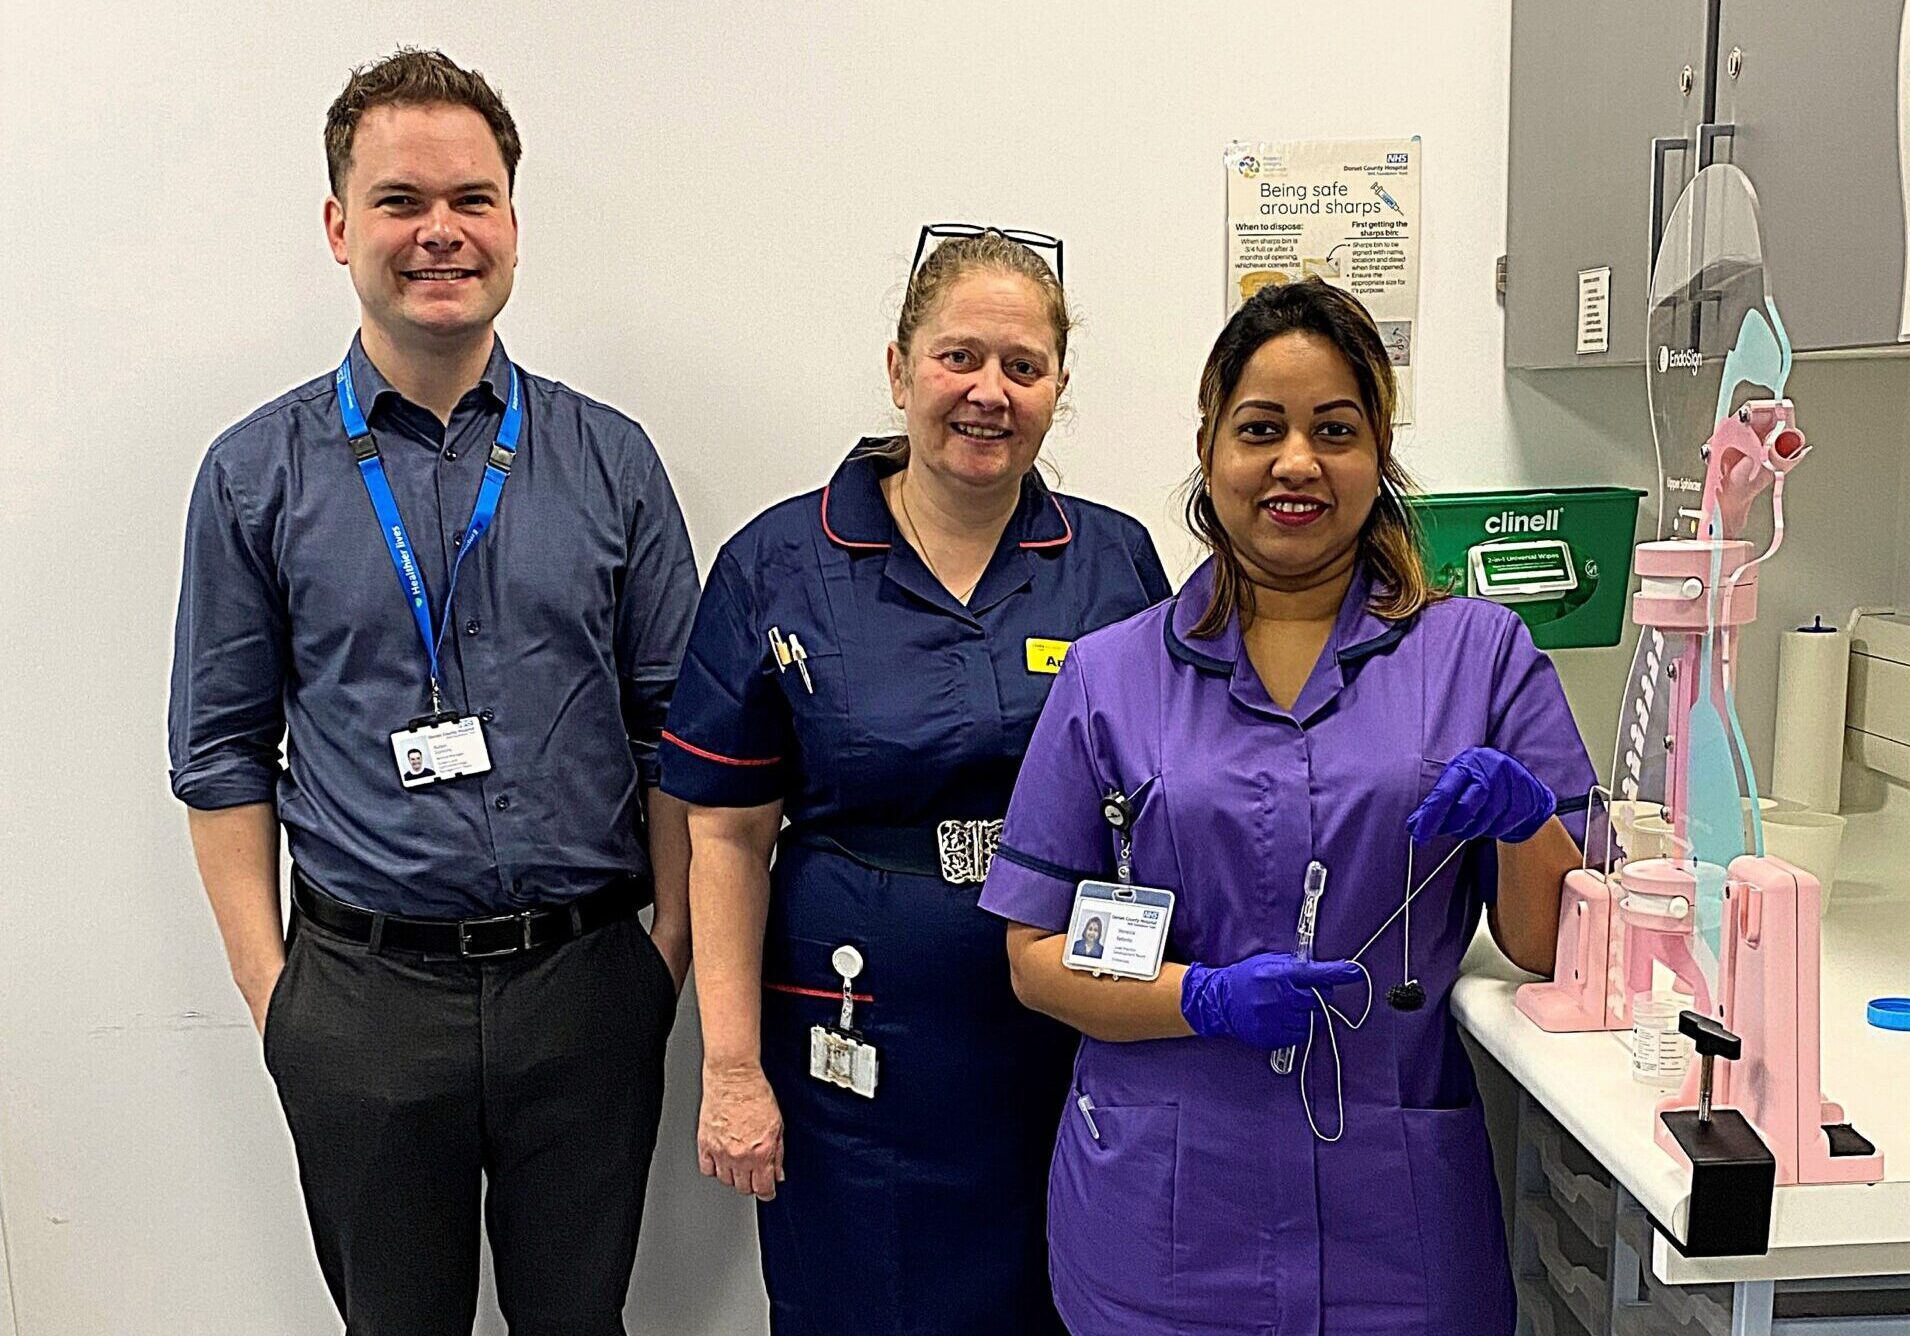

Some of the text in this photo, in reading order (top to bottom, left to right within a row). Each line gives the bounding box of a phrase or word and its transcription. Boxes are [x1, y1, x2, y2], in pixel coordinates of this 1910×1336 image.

[1387, 153, 1408, 163] NHS
[1260, 181, 1348, 200] Being safe
[1260, 199, 1381, 216] around sharps
[1235, 223, 1259, 231] When
[1270, 223, 1304, 231] dispose:
[1368, 221, 1395, 229] getting
[1360, 230, 1384, 238] sharps
[1669, 348, 1703, 377] EndoSign
[1666, 476, 1680, 491] Upper
[391, 525, 421, 595] Healthier lives
[1506, 554, 1537, 562] Universal
